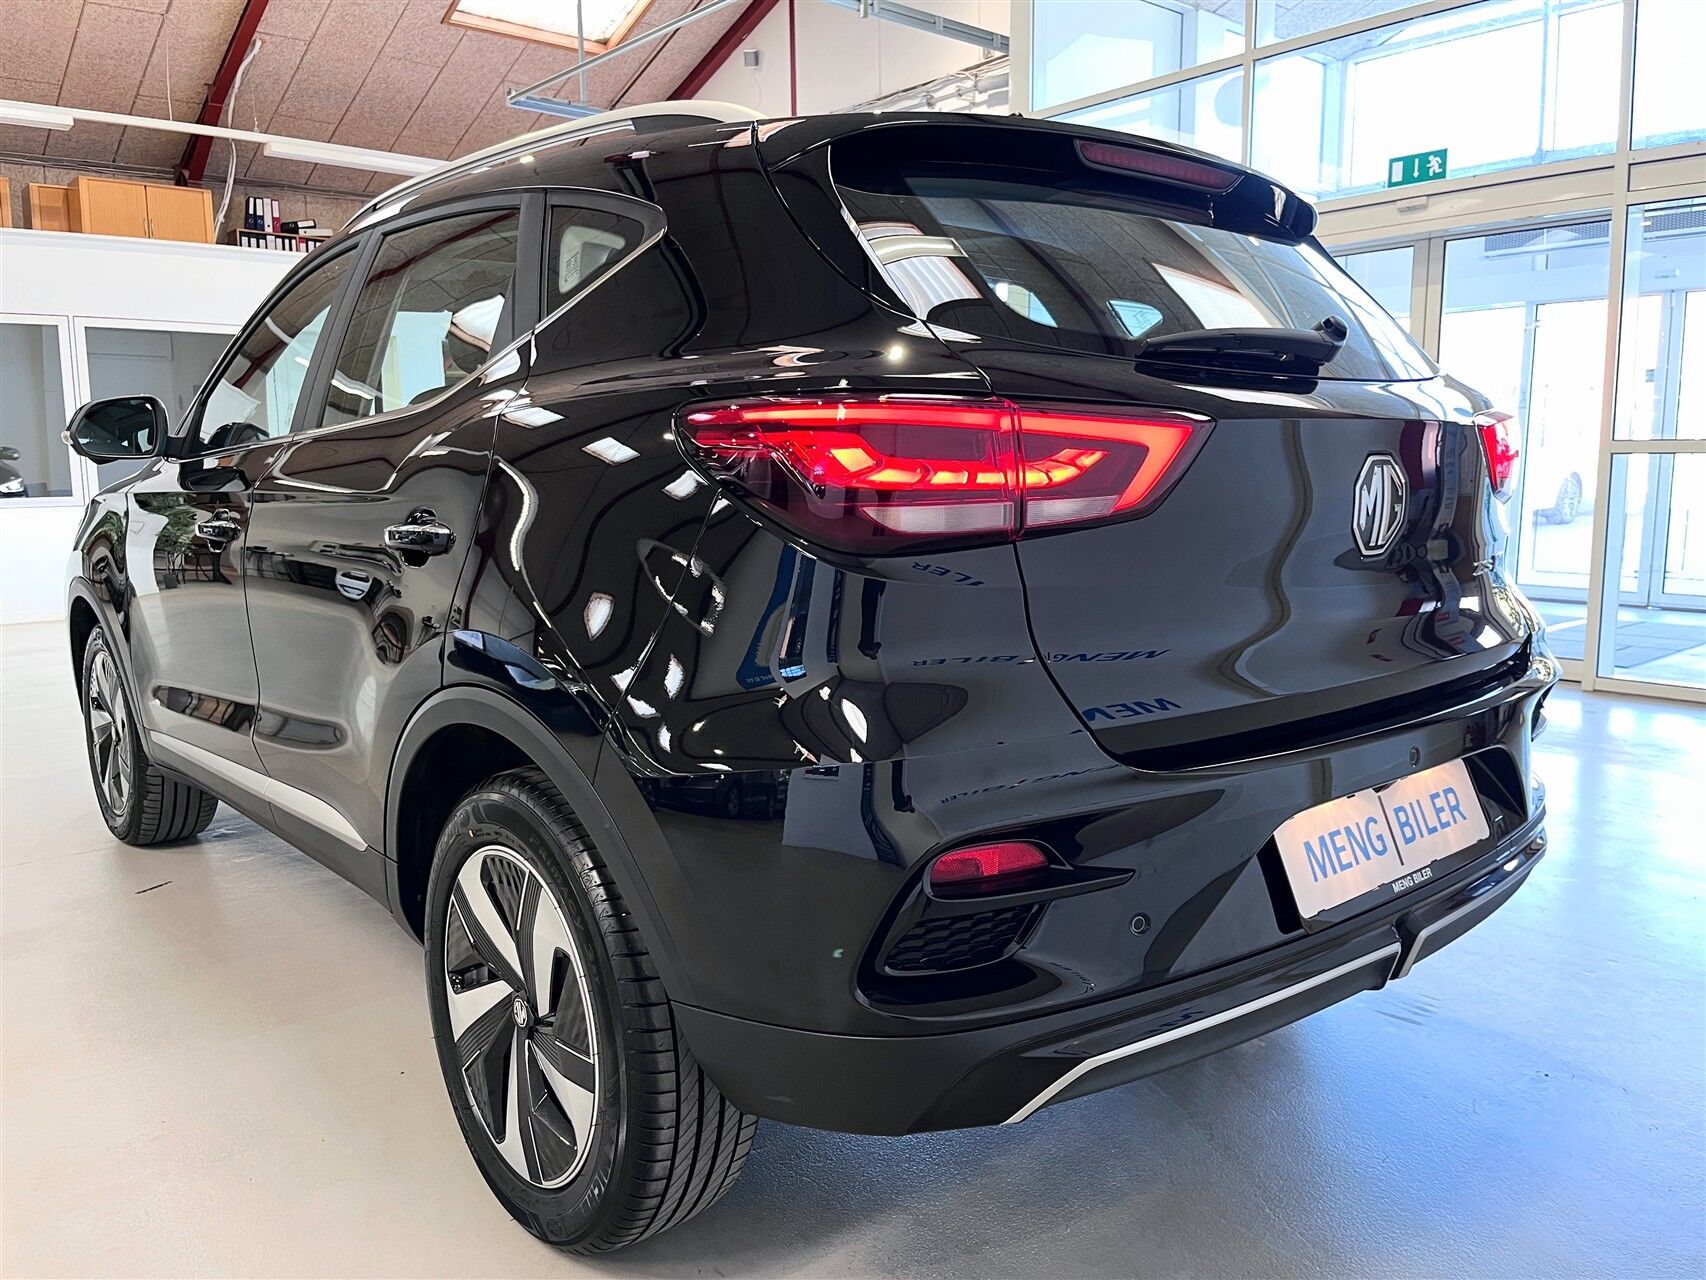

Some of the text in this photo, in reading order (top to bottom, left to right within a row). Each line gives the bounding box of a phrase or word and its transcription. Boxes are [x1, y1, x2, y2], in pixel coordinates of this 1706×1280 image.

[1358, 464, 1404, 547] MG
[1303, 786, 1468, 882] MENG BILER
[1392, 867, 1432, 893] MENG BILER
